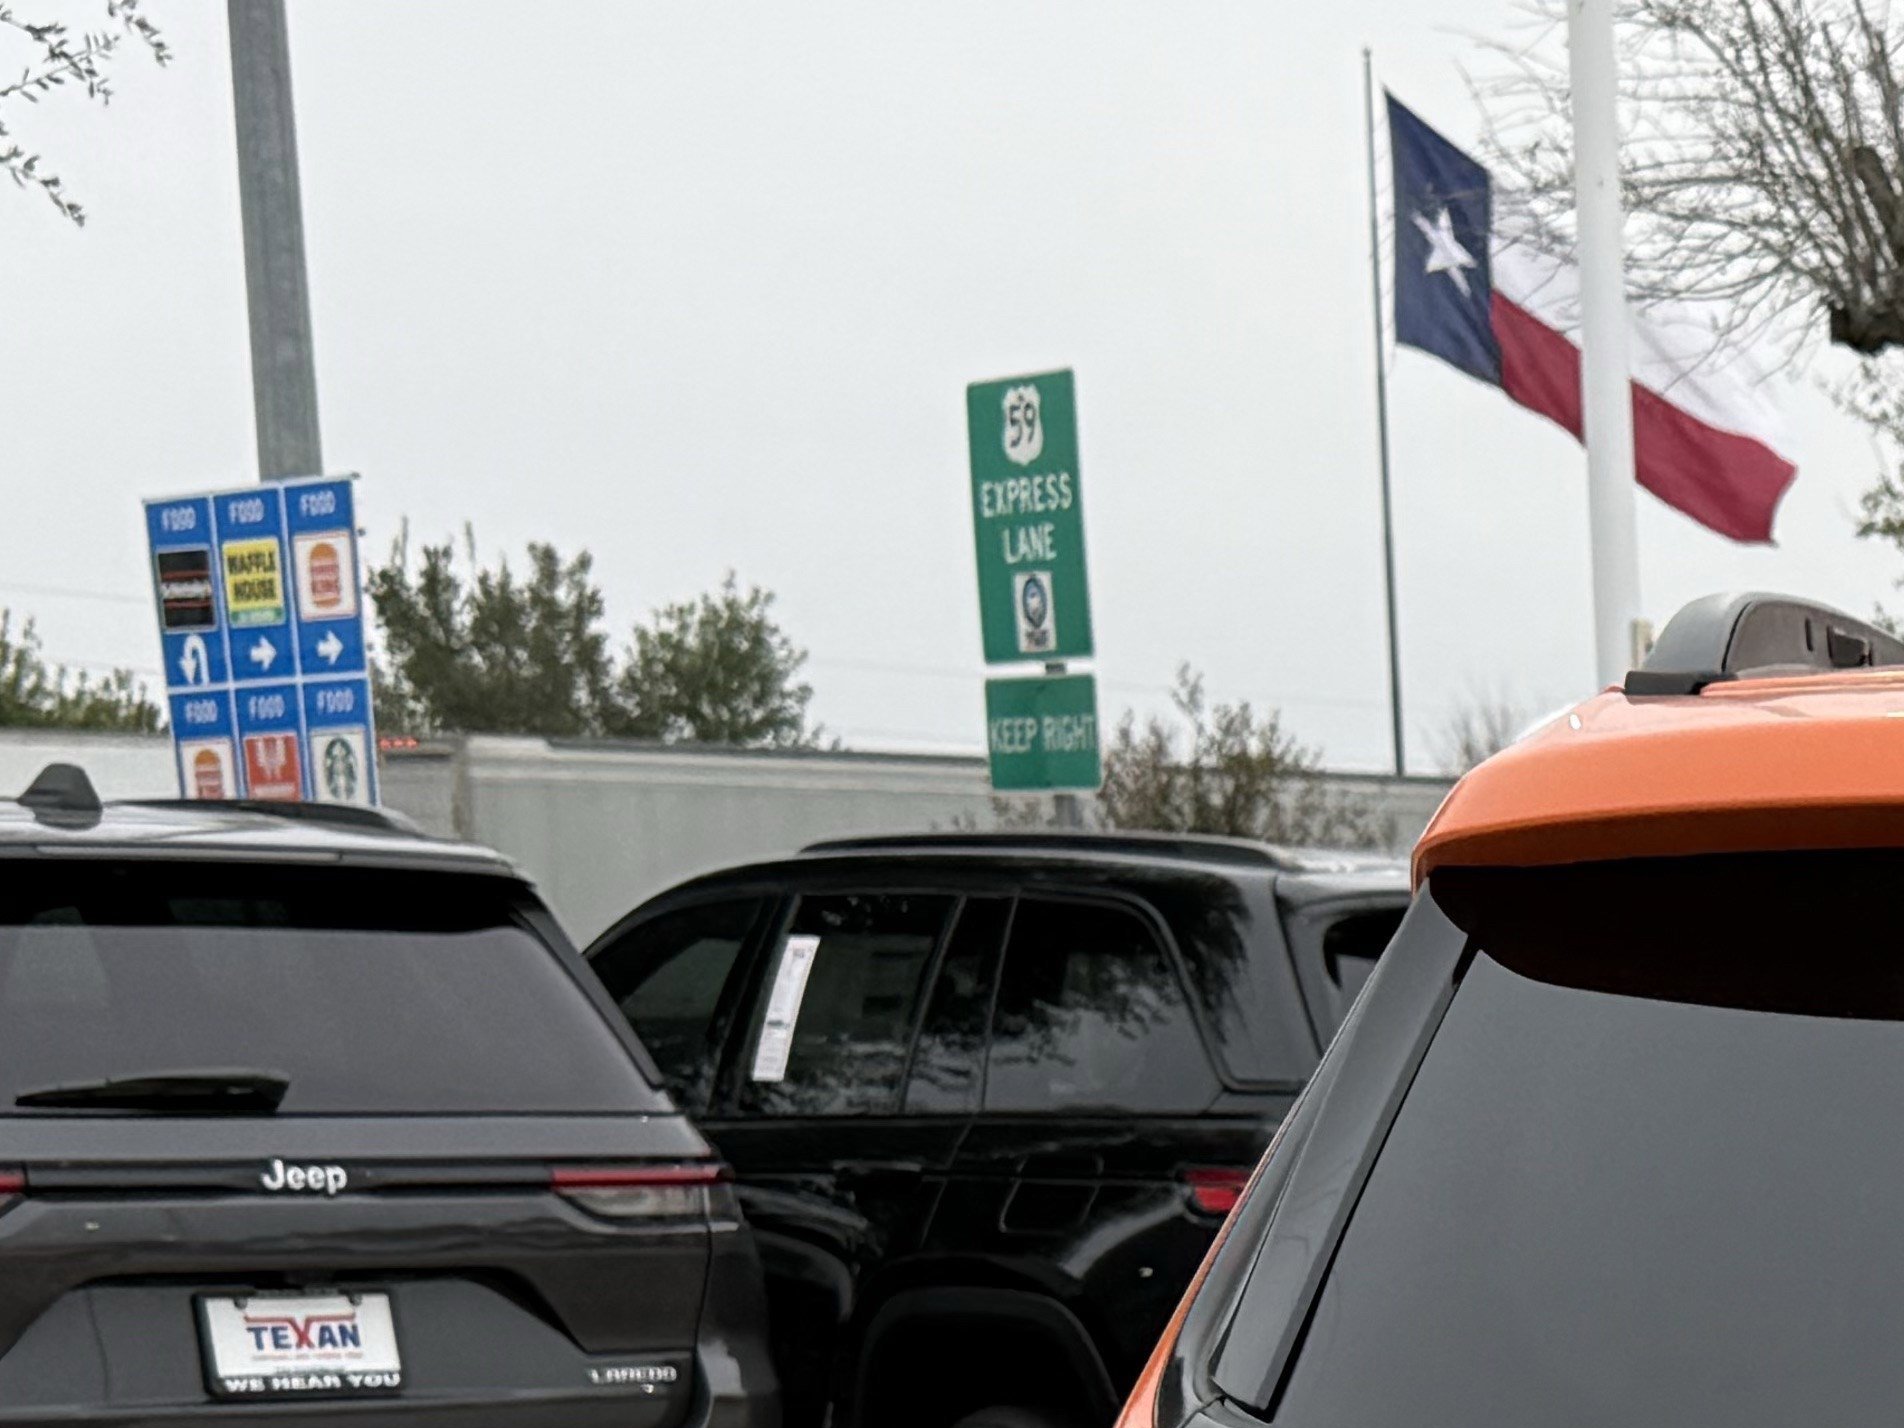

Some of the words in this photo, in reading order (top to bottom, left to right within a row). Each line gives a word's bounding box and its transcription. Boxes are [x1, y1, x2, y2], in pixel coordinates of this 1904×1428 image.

[1008, 401, 1037, 449] 59
[300, 490, 336, 517] FOOD
[981, 471, 1072, 520] EXPRESS
[161, 507, 197, 532] FOOD
[229, 497, 265, 525] FOOD
[1002, 522, 1057, 565] LANE
[227, 550, 276, 576] WAFFLE
[233, 578, 276, 602] HOUSE
[185, 699, 219, 725] FOOD
[249, 694, 286, 720] FOOD
[316, 687, 354, 714] FOOD
[989, 717, 1037, 755] KEEP
[1042, 714, 1096, 752] RIGHT
[261, 1158, 348, 1195] Jeep
[246, 1319, 361, 1350] TEXAN
[224, 1378, 265, 1393] WE
[271, 1374, 341, 1391] HEAR
[347, 1371, 400, 1388] YOU
